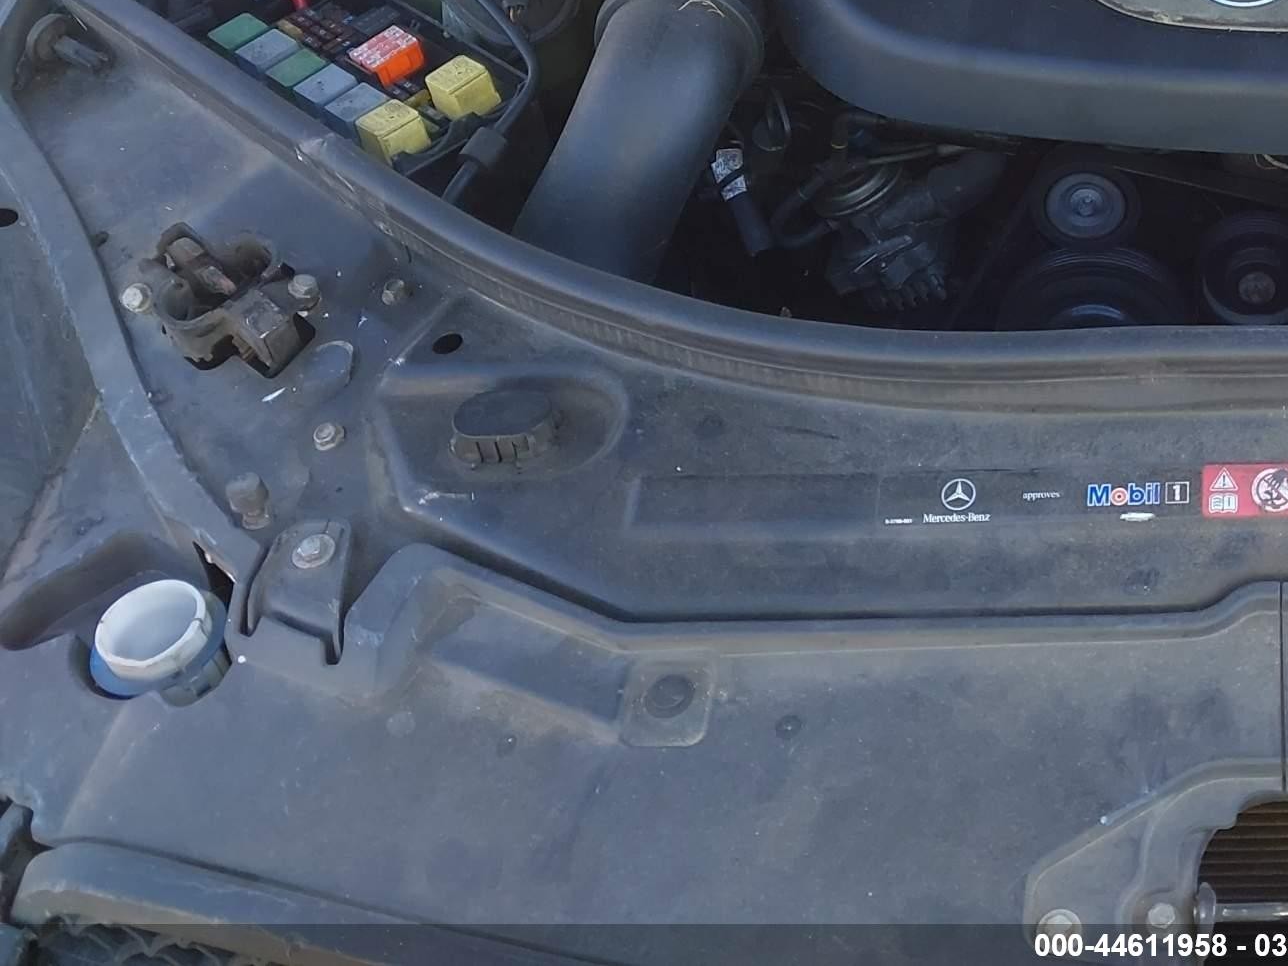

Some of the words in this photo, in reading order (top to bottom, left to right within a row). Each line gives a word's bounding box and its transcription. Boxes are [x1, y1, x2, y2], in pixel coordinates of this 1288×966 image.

[1022, 490, 1061, 501] approves
[1086, 482, 1161, 507] Mobil
[922, 512, 992, 524] Mercedes-Benz
